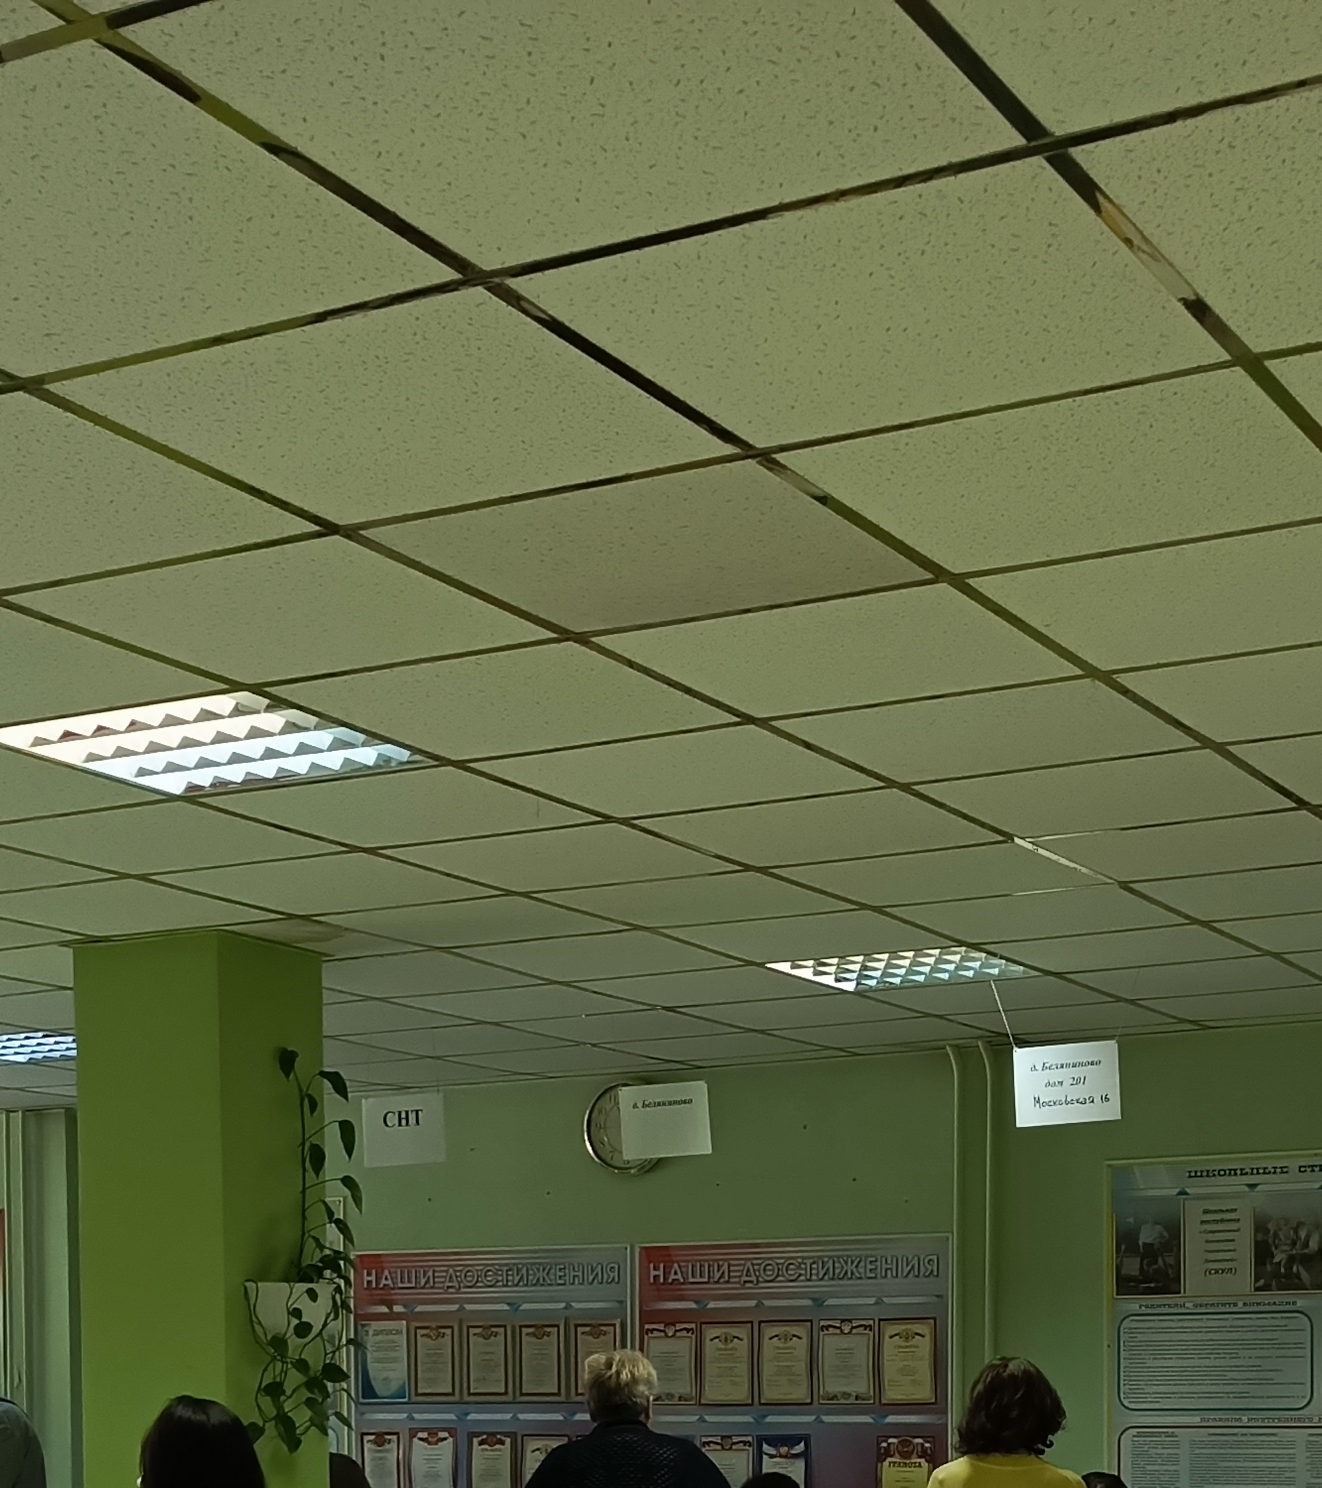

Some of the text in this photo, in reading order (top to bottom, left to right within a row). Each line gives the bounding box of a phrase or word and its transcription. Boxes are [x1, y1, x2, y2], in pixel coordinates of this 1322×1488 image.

[1045, 1075, 1087, 1088] дом 201
[1033, 1094, 1095, 1109] Московская
[382, 1108, 424, 1128] СНТ
[1187, 1166, 1289, 1179] ШКОЛЬНЫЕ
[362, 1262, 621, 1292] НАШИ ДОСТИЖЕНИЯ
[649, 1255, 941, 1287] НАШИ ДОСТИЖЕНИЯ
